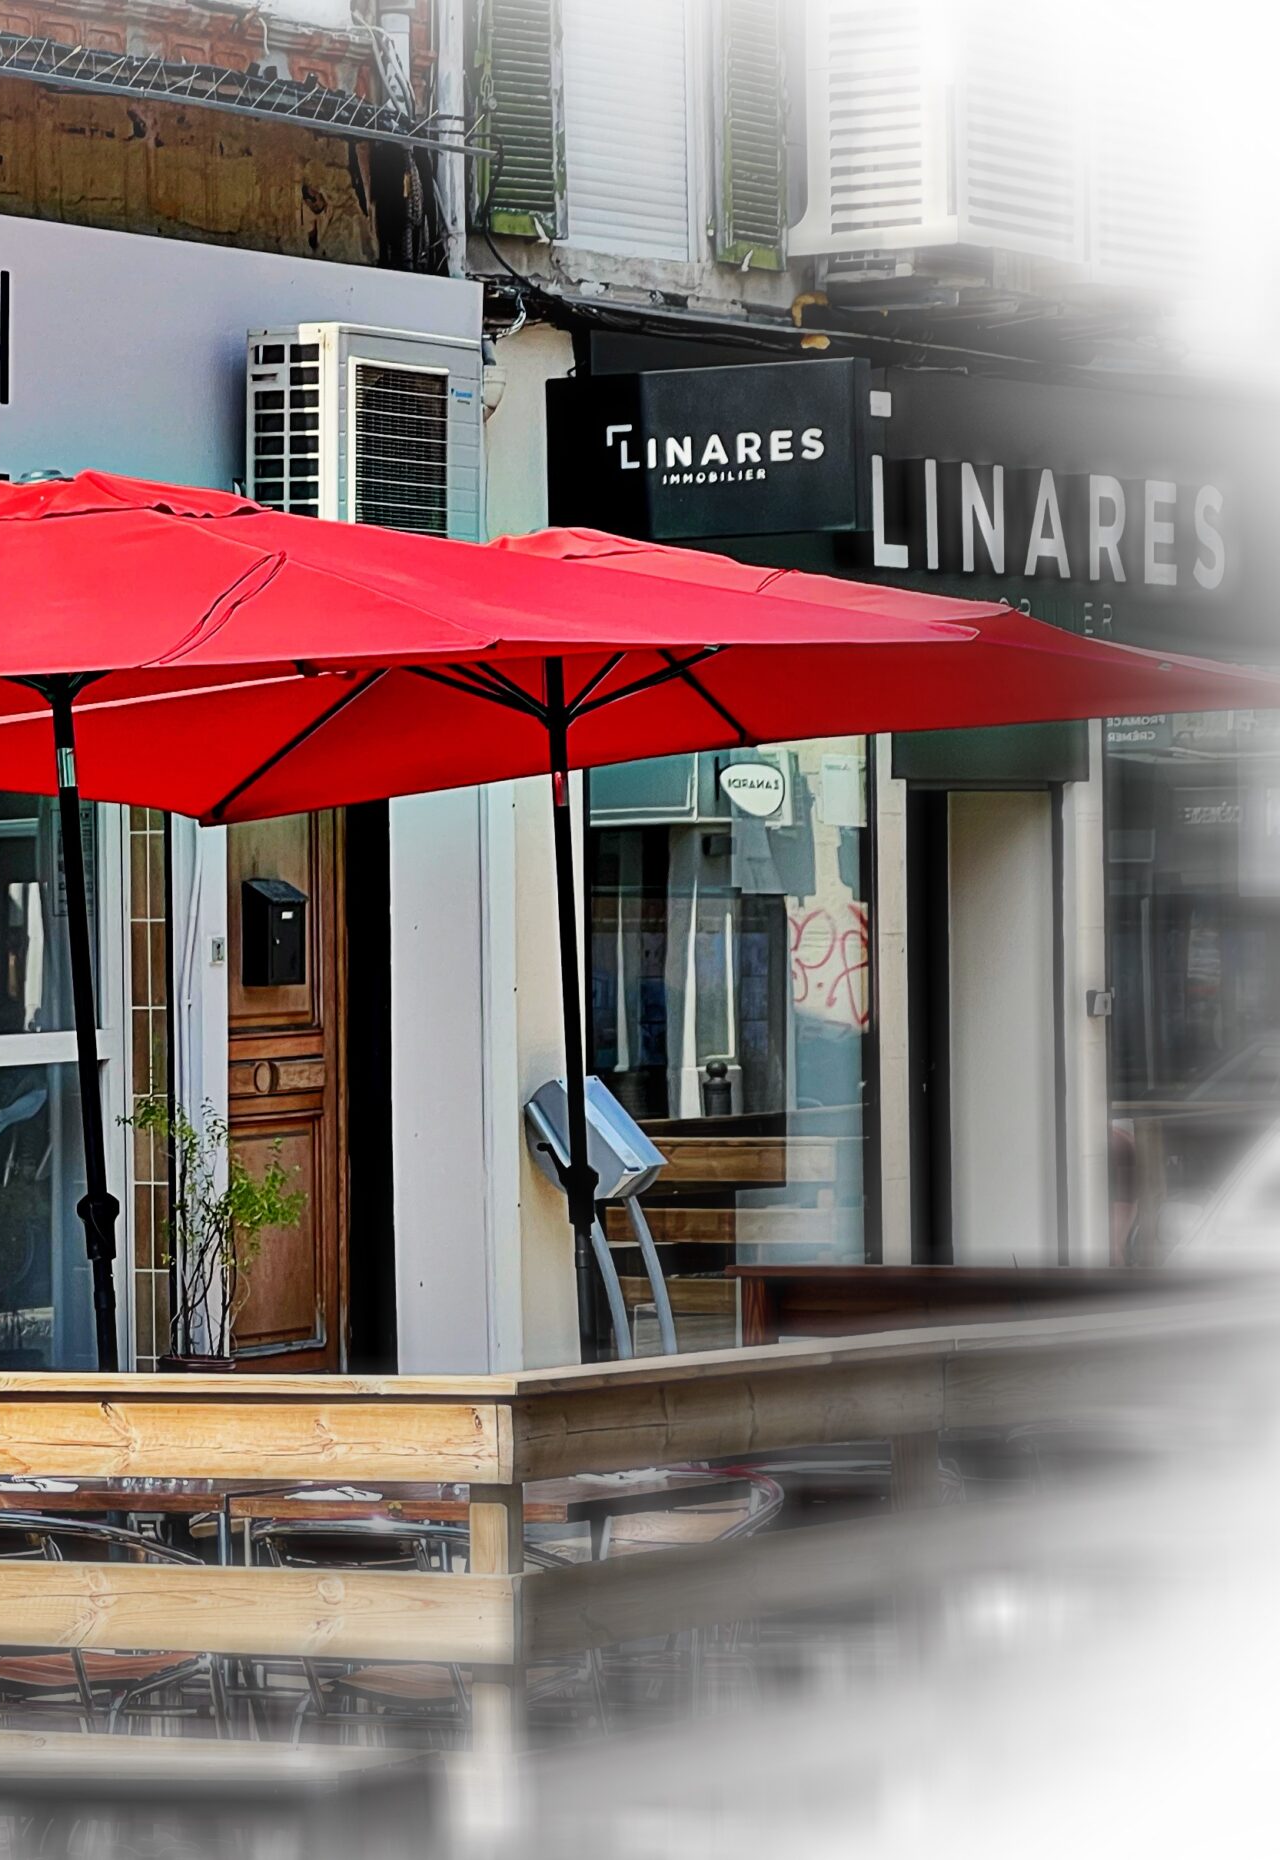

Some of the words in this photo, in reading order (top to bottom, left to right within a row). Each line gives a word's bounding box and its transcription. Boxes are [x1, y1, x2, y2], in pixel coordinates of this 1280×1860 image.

[620, 428, 825, 469] LINARES
[662, 468, 766, 485] IMMOBILIER
[871, 454, 1226, 590] LINARES
